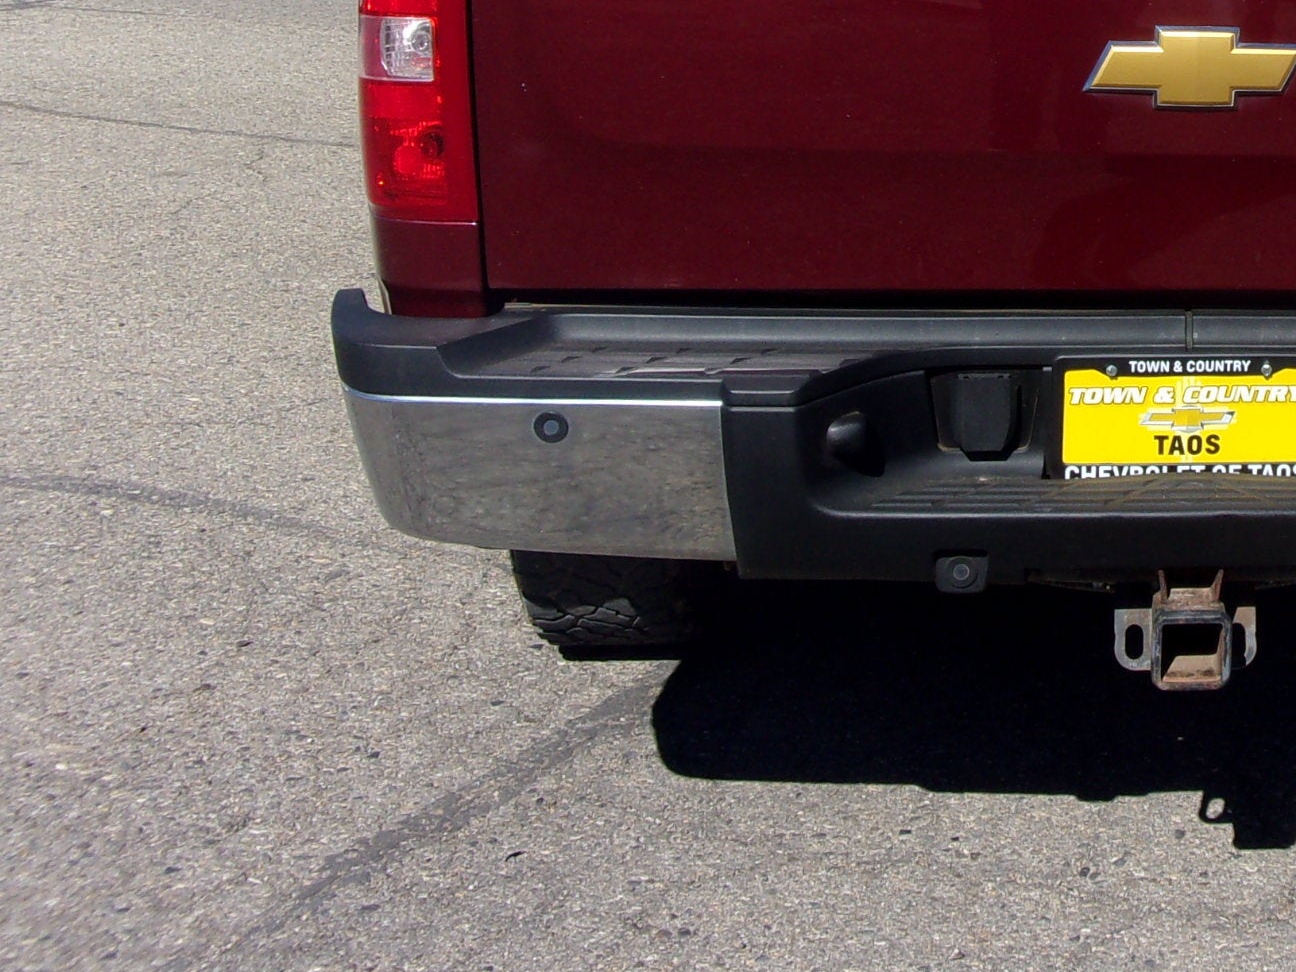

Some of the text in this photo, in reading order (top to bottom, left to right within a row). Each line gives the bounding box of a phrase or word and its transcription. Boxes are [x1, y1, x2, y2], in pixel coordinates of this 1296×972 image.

[1129, 360, 1251, 373] TOWN & COUNTRY
[1068, 386, 1148, 405] TOWN
[1153, 386, 1175, 404] &
[1153, 434, 1221, 456] TAOS
